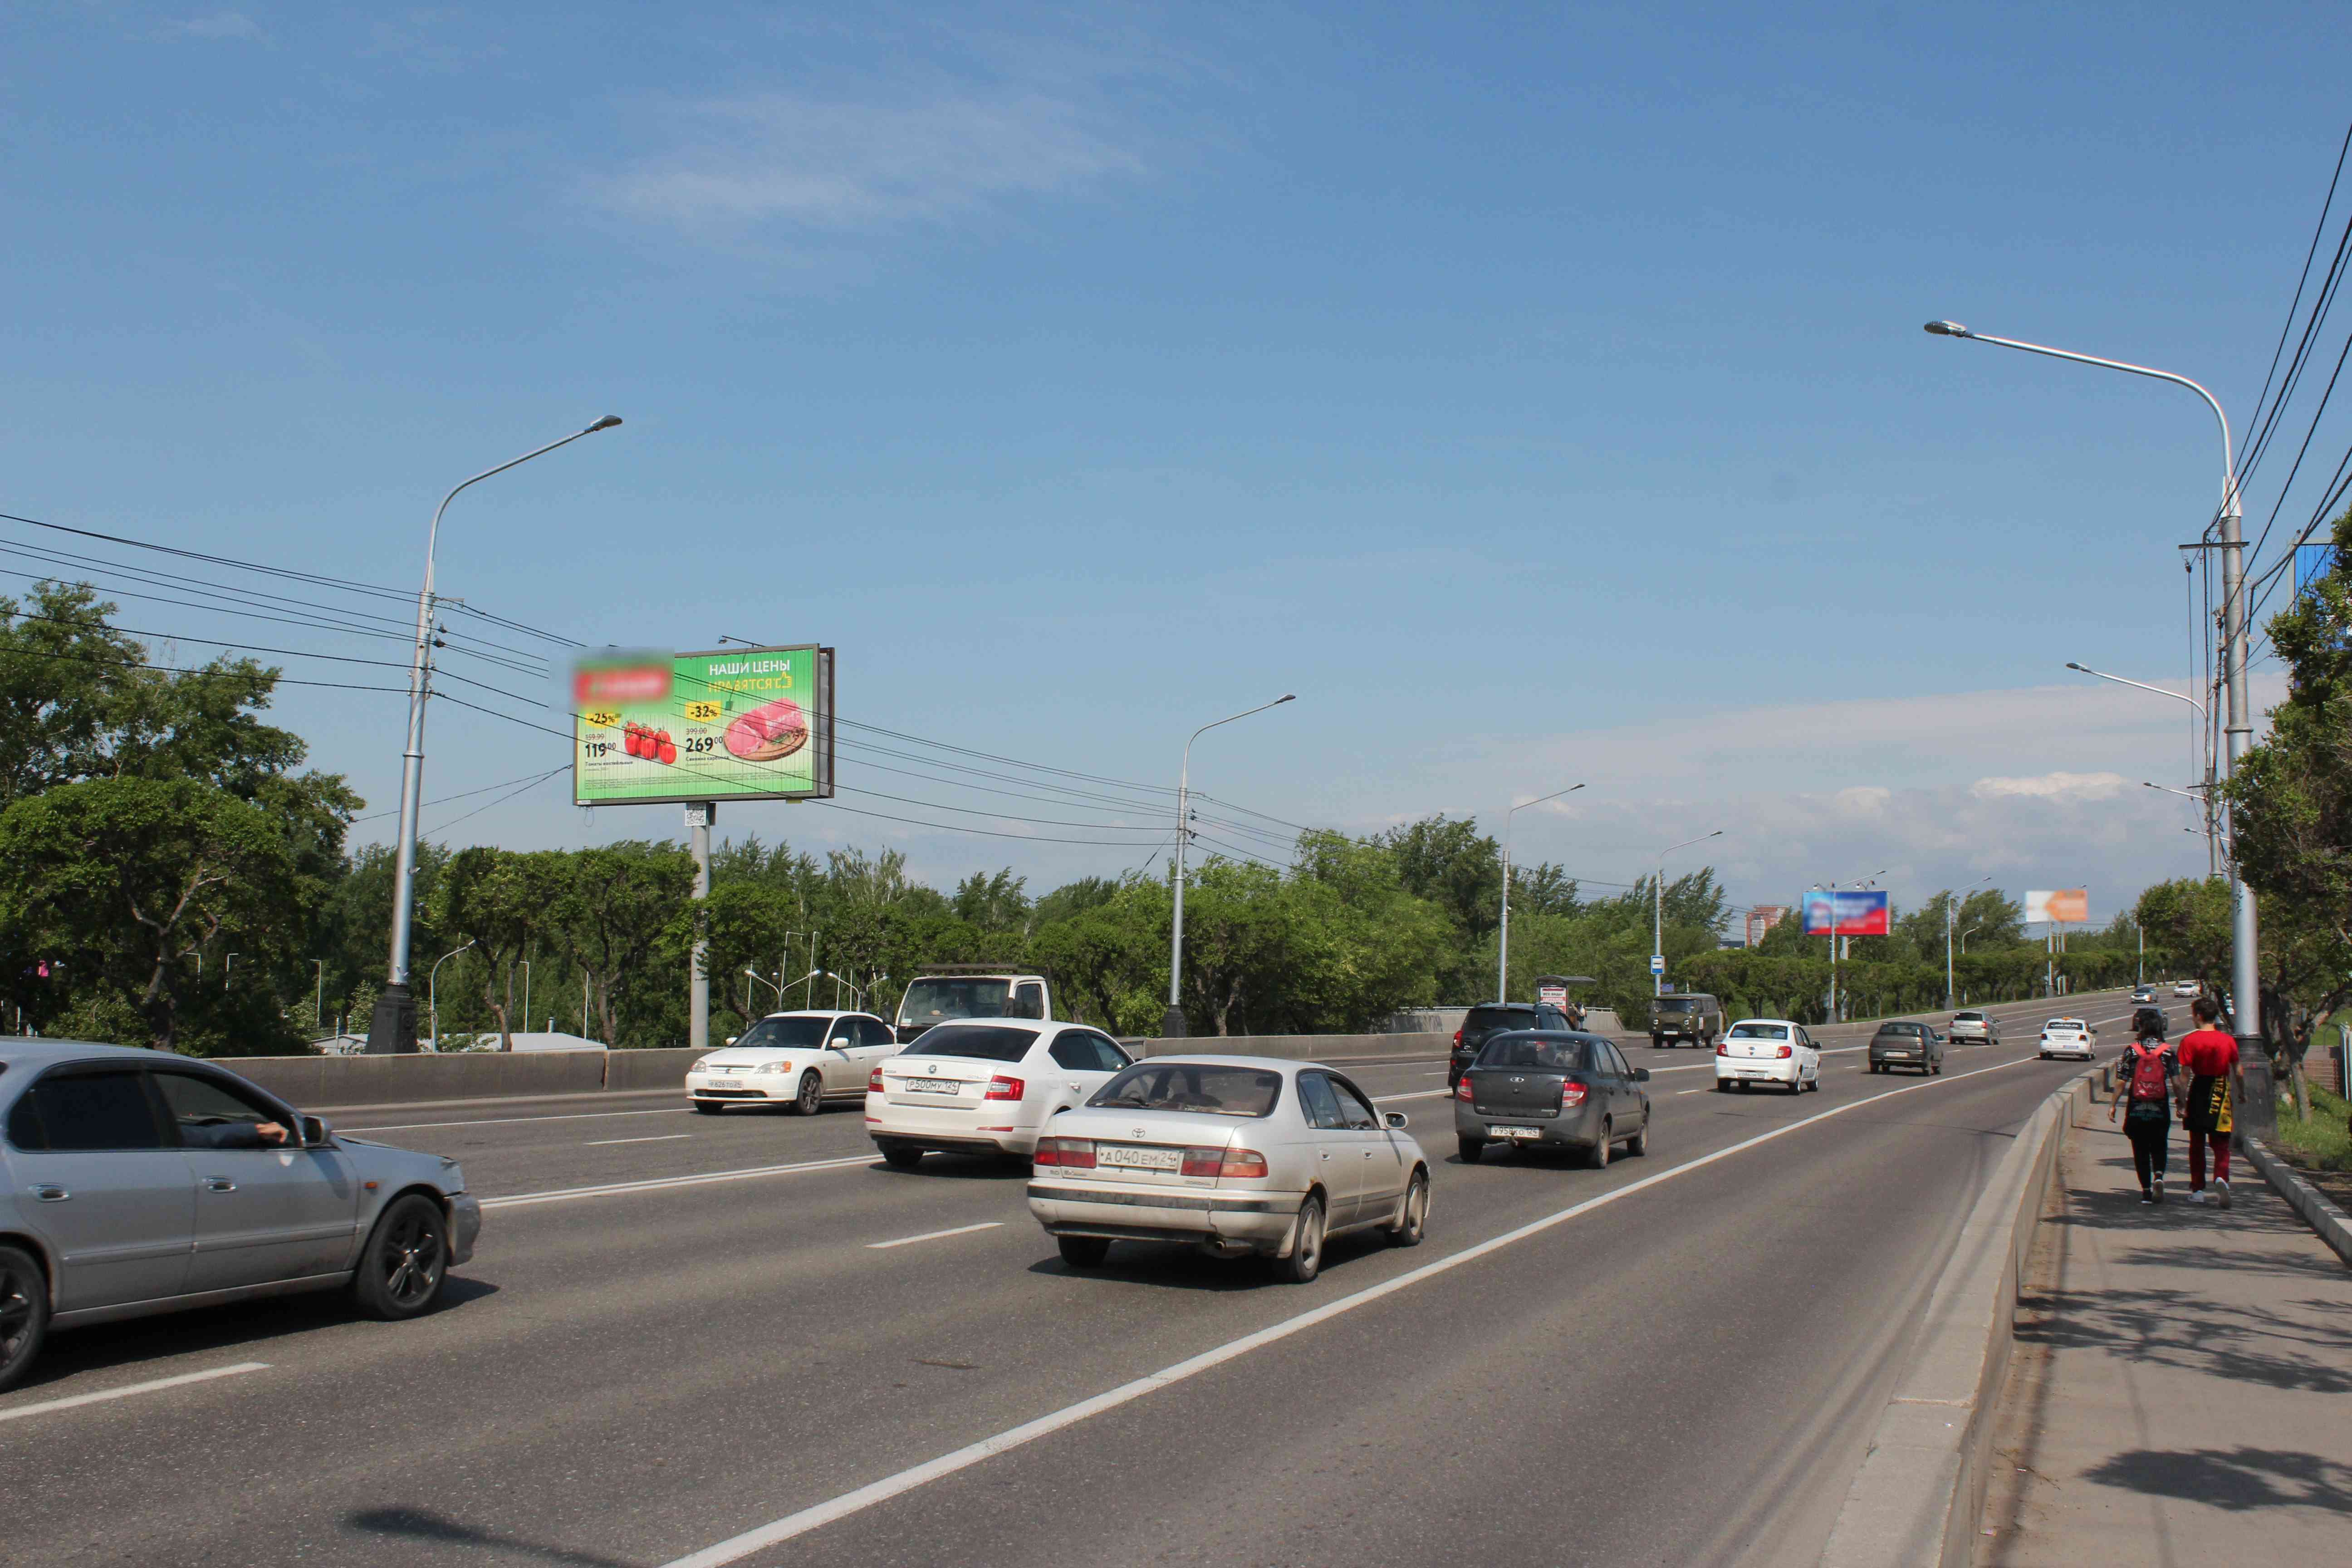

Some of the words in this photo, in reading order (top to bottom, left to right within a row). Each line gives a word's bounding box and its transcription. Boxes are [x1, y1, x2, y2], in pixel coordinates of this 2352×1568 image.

[709, 662, 749, 676] НАШИ
[753, 660, 790, 674] ЦЕНЫ
[708, 678, 773, 693] НРАВЯТСЯ
[691, 706, 717, 717] -32%
